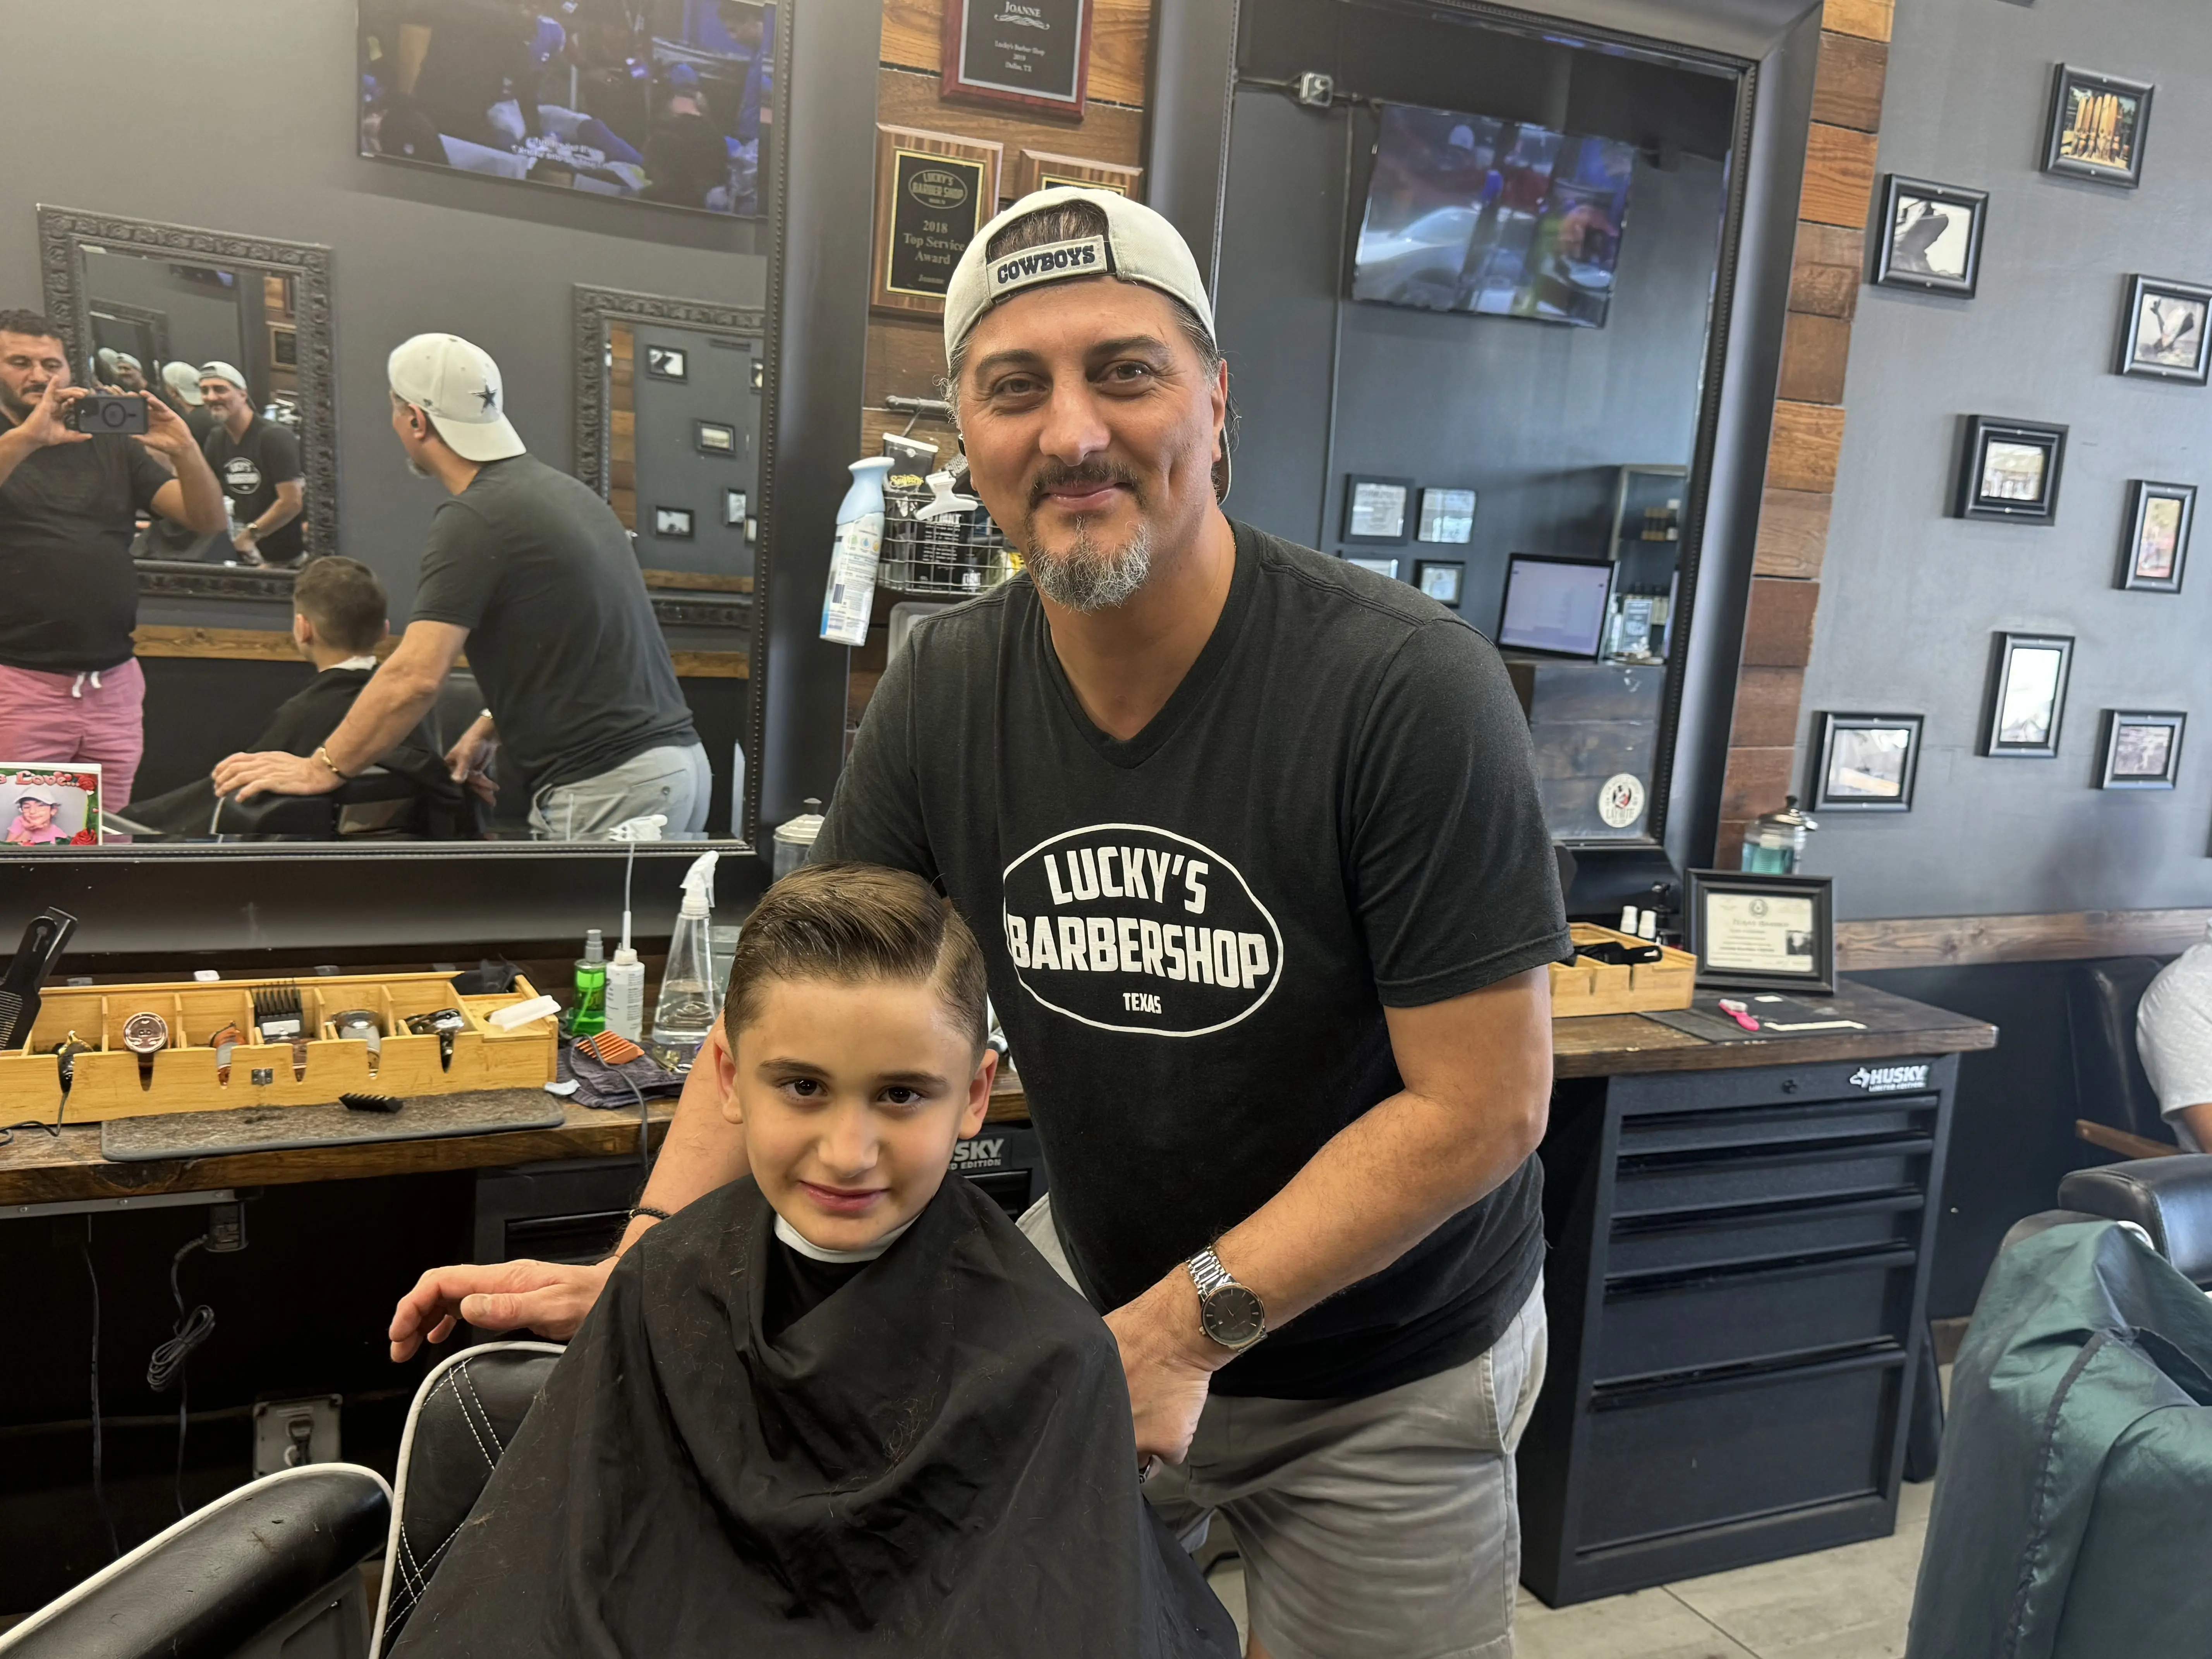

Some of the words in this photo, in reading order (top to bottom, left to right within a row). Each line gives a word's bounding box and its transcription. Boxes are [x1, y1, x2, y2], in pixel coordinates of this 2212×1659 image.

[923, 220, 948, 234] 2018
[903, 233, 924, 248] Top
[926, 236, 965, 251] Service
[915, 251, 951, 264] Award
[997, 245, 1095, 284] COWBOYS
[1044, 846, 1209, 914] LUCKY'S
[1007, 913, 1270, 989] BARBERSHOP
[1123, 993, 1162, 1014] TEXAS
[1869, 1065, 1929, 1084] HUSKY
[954, 1139, 1004, 1161] SKY
[961, 1159, 1001, 1169] EDITION
